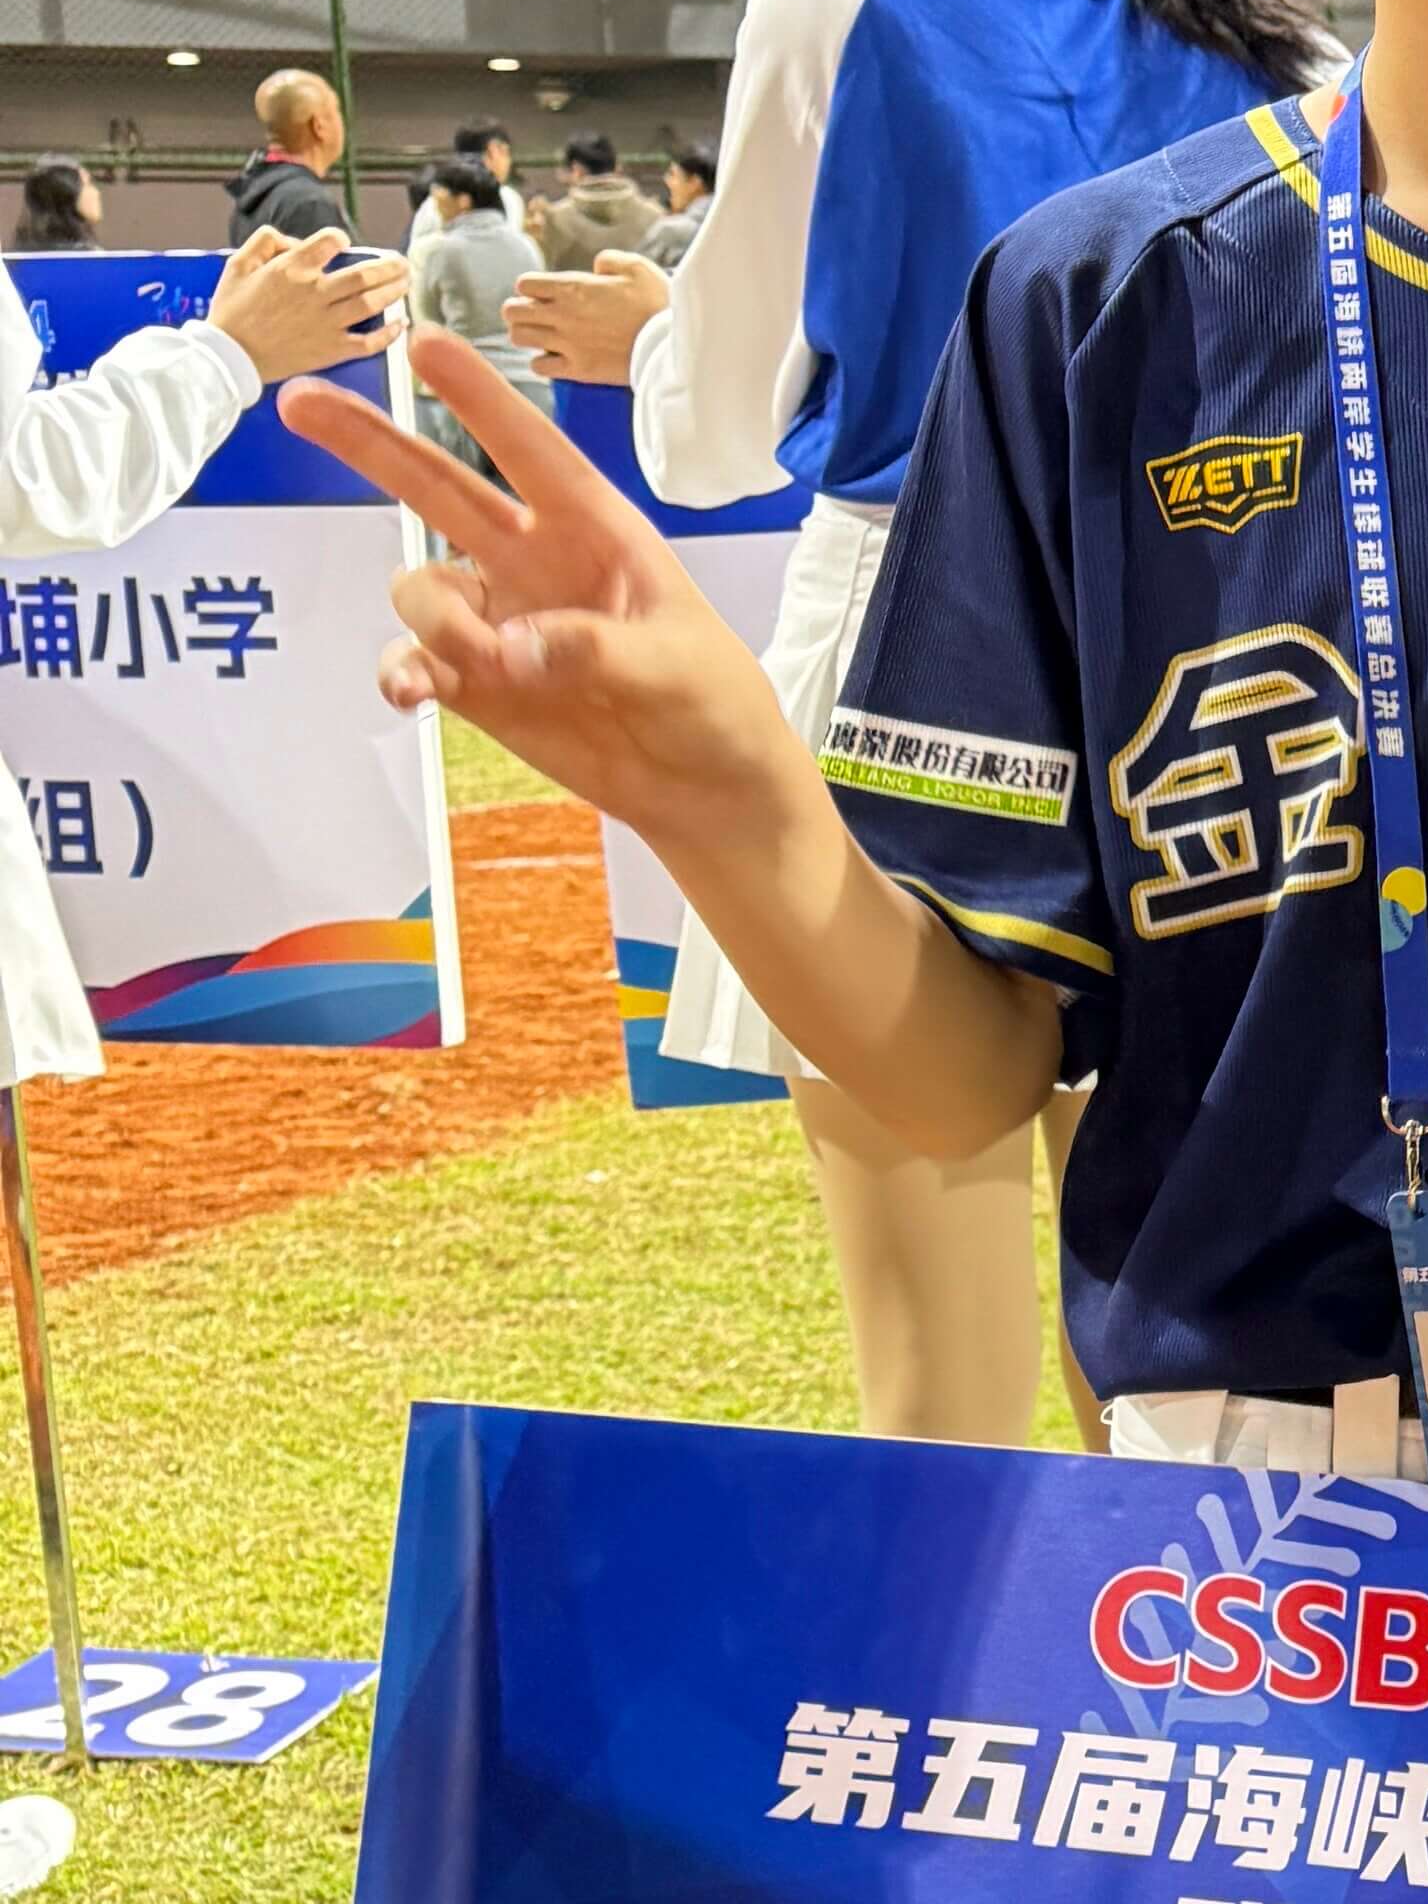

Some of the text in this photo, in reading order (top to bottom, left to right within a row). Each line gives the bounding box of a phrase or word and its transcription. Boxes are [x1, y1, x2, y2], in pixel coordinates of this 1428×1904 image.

[1162, 445, 1292, 507] ZETT
[1326, 191, 1403, 758] 第五届海峡两岸学生棒球联赛总决赛
